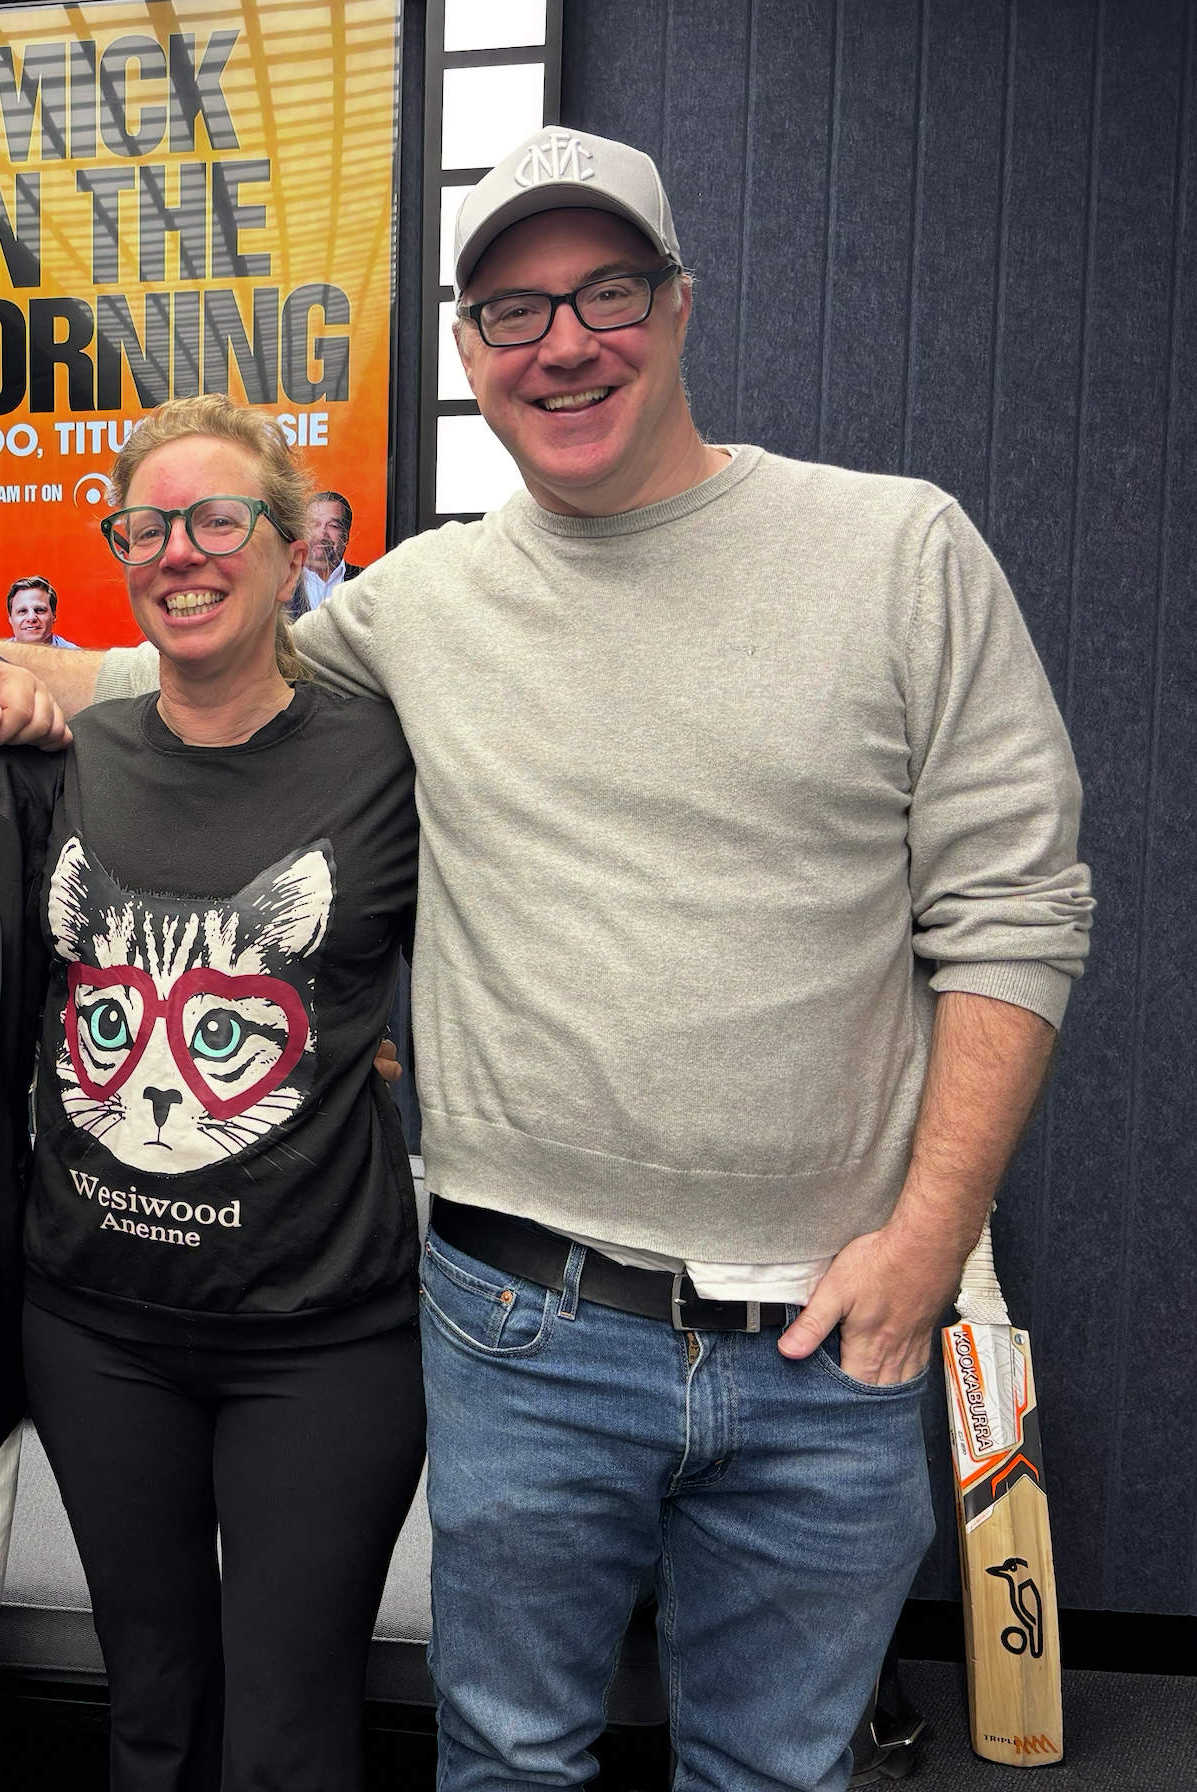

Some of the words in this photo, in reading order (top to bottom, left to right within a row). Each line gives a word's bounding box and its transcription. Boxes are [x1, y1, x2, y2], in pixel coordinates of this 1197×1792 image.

[76, 159, 271, 285] THE
[55, 420, 139, 455] TITU
[276, 412, 329, 447] SIE
[24, 484, 38, 503] IT
[41, 484, 63, 502] ON
[69, 1168, 242, 1228] Wesiwood
[100, 1212, 201, 1247] Anenne
[954, 1331, 993, 1452] KOOKABURRA
